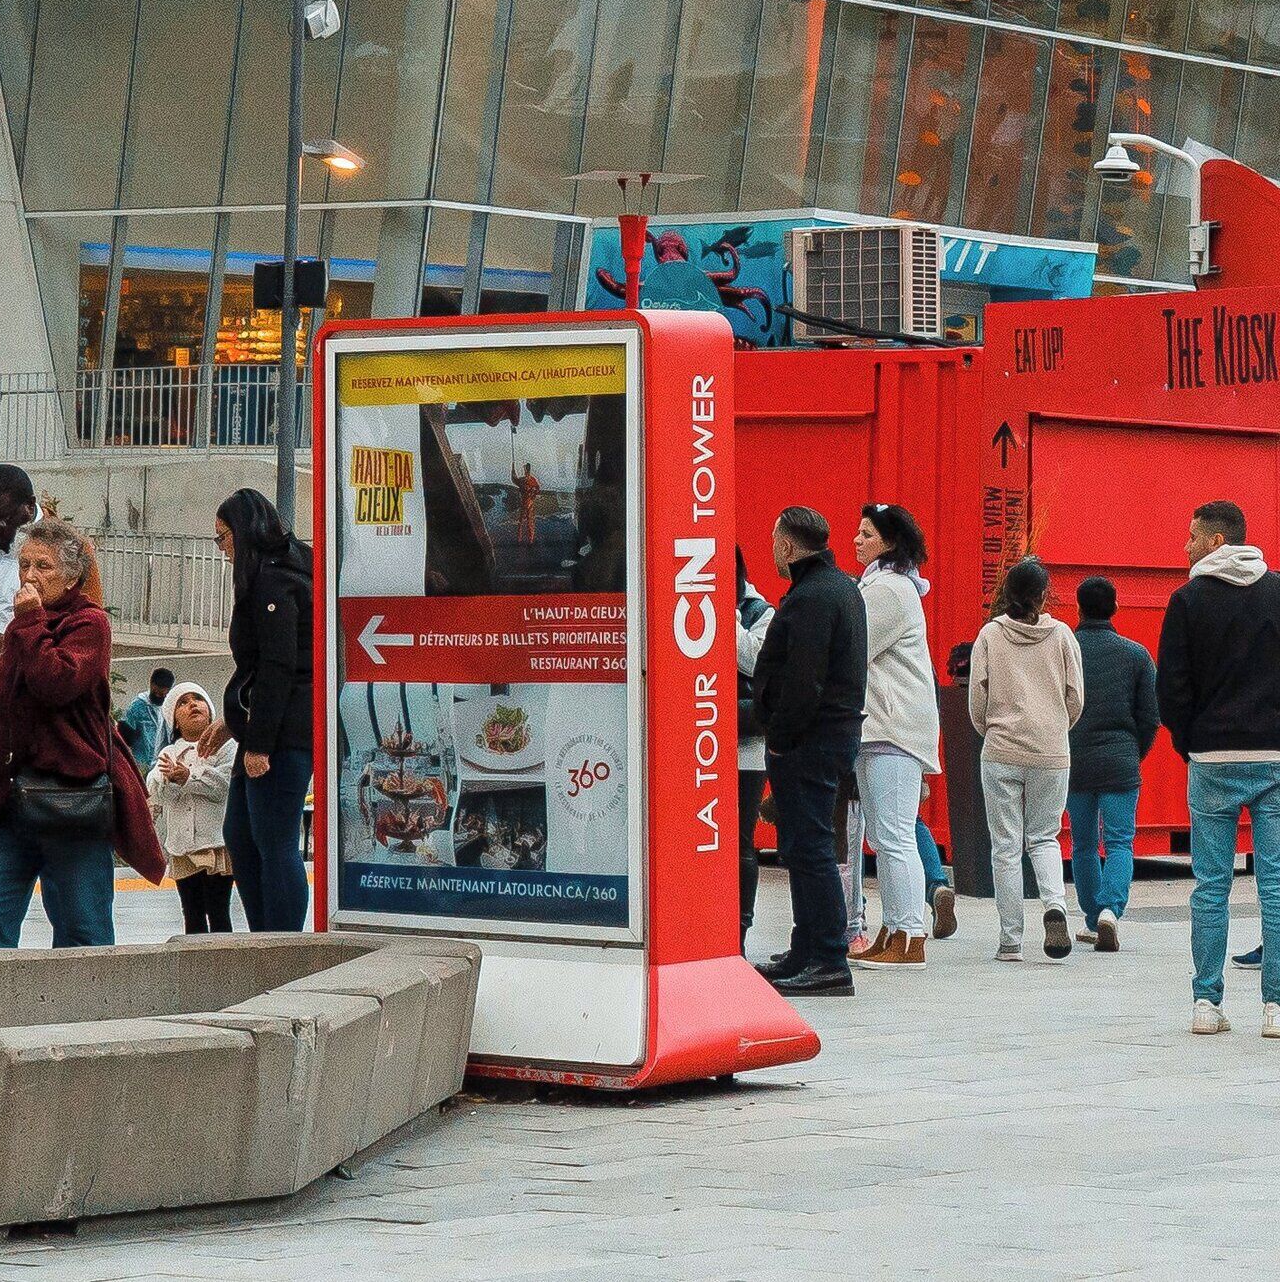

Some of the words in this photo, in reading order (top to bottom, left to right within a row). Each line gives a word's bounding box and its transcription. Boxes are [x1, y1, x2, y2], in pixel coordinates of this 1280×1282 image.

[1014, 328, 1037, 373] EAT
[1042, 326, 1064, 371] UP!
[1162, 308, 1206, 390] THE
[1213, 305, 1279, 386] KIOSK
[395, 372, 464, 388] MAINTENANT
[692, 374, 716, 523] TOWER
[354, 449, 412, 489] HAUT-DA
[357, 487, 400, 522] CIEUX
[982, 486, 1003, 527] VIEW
[590, 606, 626, 619] CIEUX
[673, 537, 717, 659] CN
[419, 630, 483, 647] DÉTENTEURS
[485, 633, 499, 646] DE
[502, 632, 549, 646] BILLETS
[552, 631, 626, 645] PRIORITAIRES
[530, 657, 599, 670] RESTAURANT
[602, 657, 627, 669] 360
[695, 672, 719, 788] TOUR
[567, 759, 610, 797] 360
[696, 797, 719, 852] LA
[360, 871, 412, 890] RÉSERVEZ
[417, 878, 495, 894] MAINTENANT
